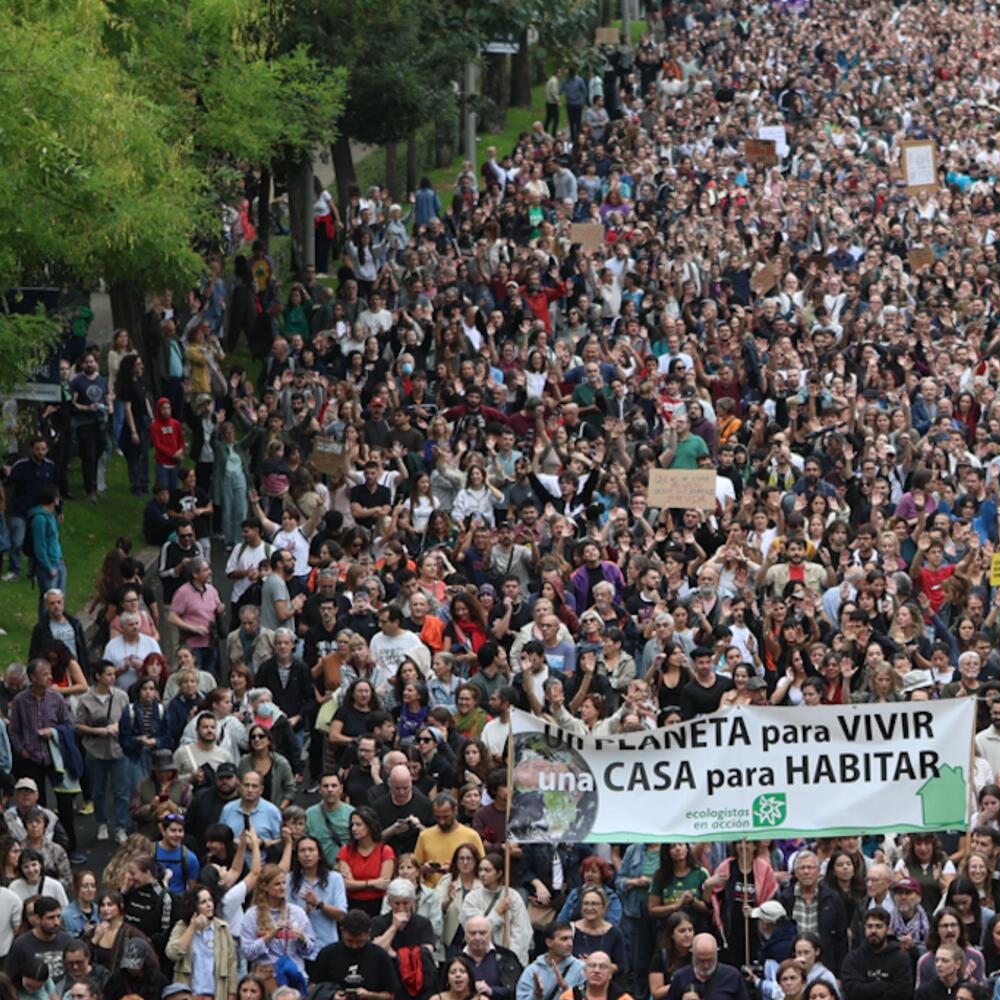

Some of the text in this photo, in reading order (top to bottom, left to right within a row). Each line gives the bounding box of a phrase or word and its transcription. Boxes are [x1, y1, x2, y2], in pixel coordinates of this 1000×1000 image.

[761, 720, 831, 752] para
[837, 710, 934, 743] VIVIR
[538, 750, 941, 796] una CASA para HABITAR
[685, 808, 750, 820] ecologistas
[694, 819, 750, 830] en acción
